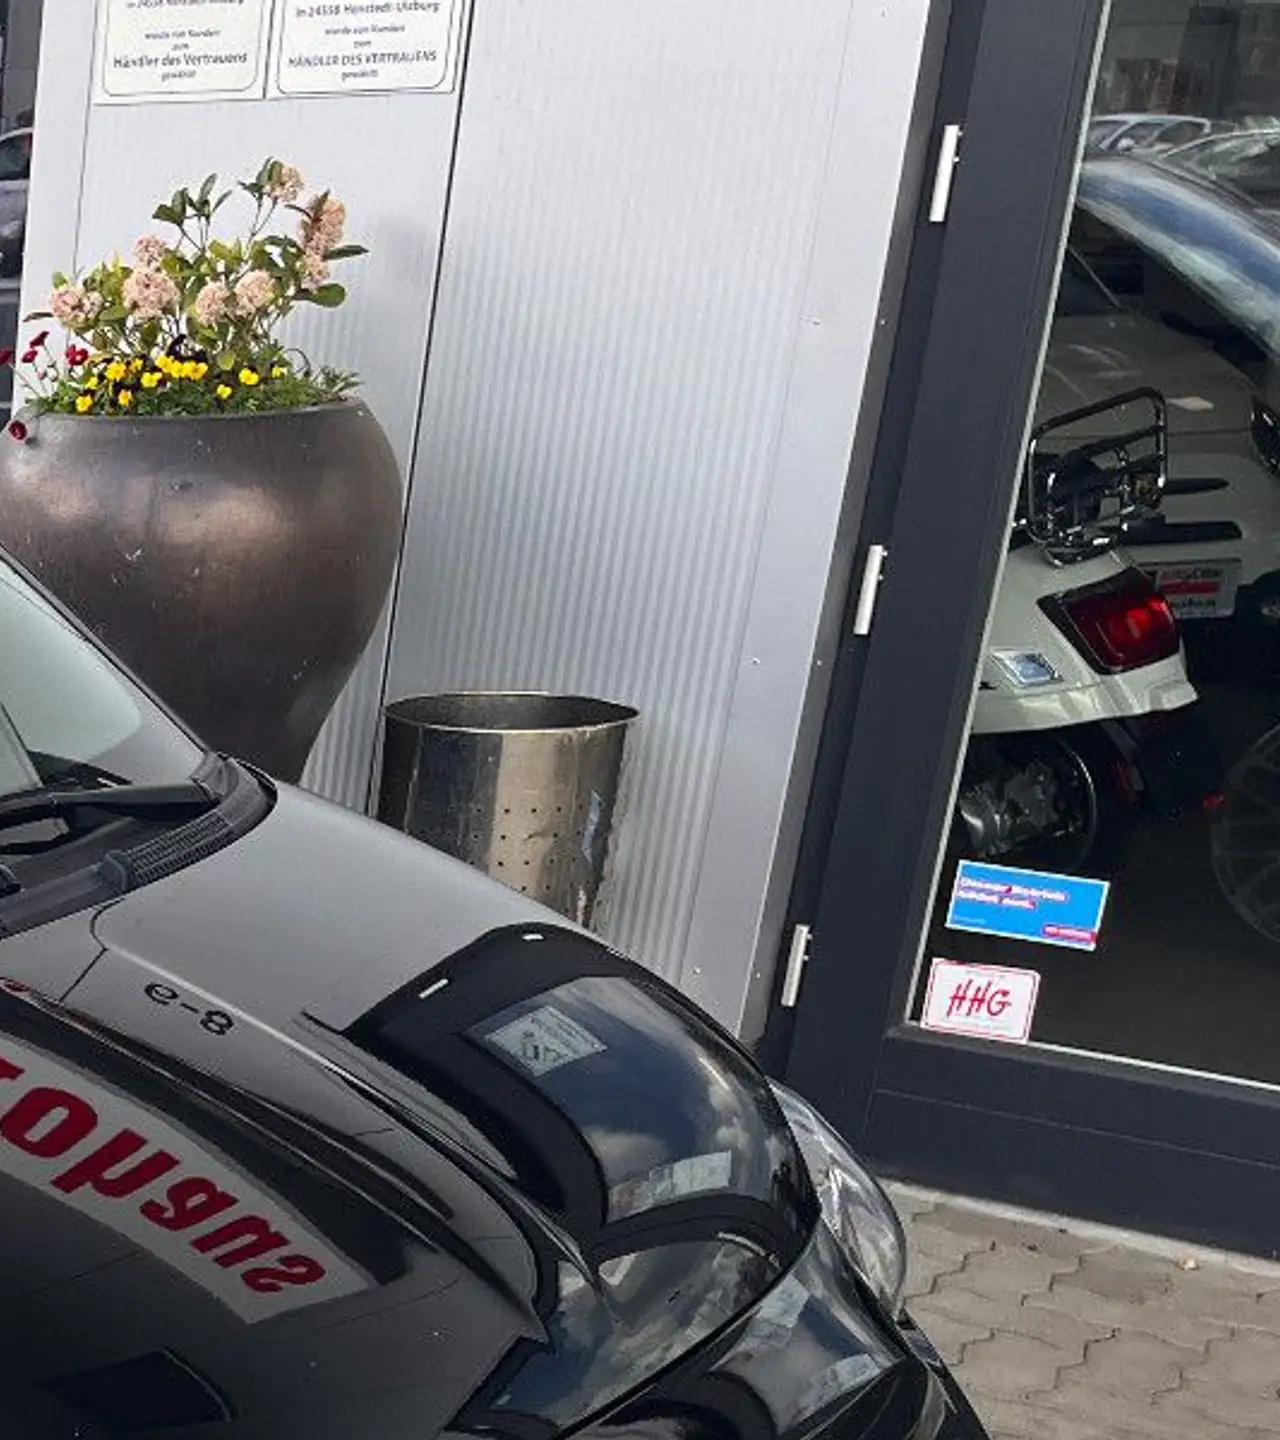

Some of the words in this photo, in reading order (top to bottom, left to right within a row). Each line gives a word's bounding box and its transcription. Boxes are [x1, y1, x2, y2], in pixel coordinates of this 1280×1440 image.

[113, 54, 159, 68] Händler
[161, 54, 181, 67] des
[184, 52, 248, 66] Vertrauens
[946, 978, 1013, 1017] HHG
